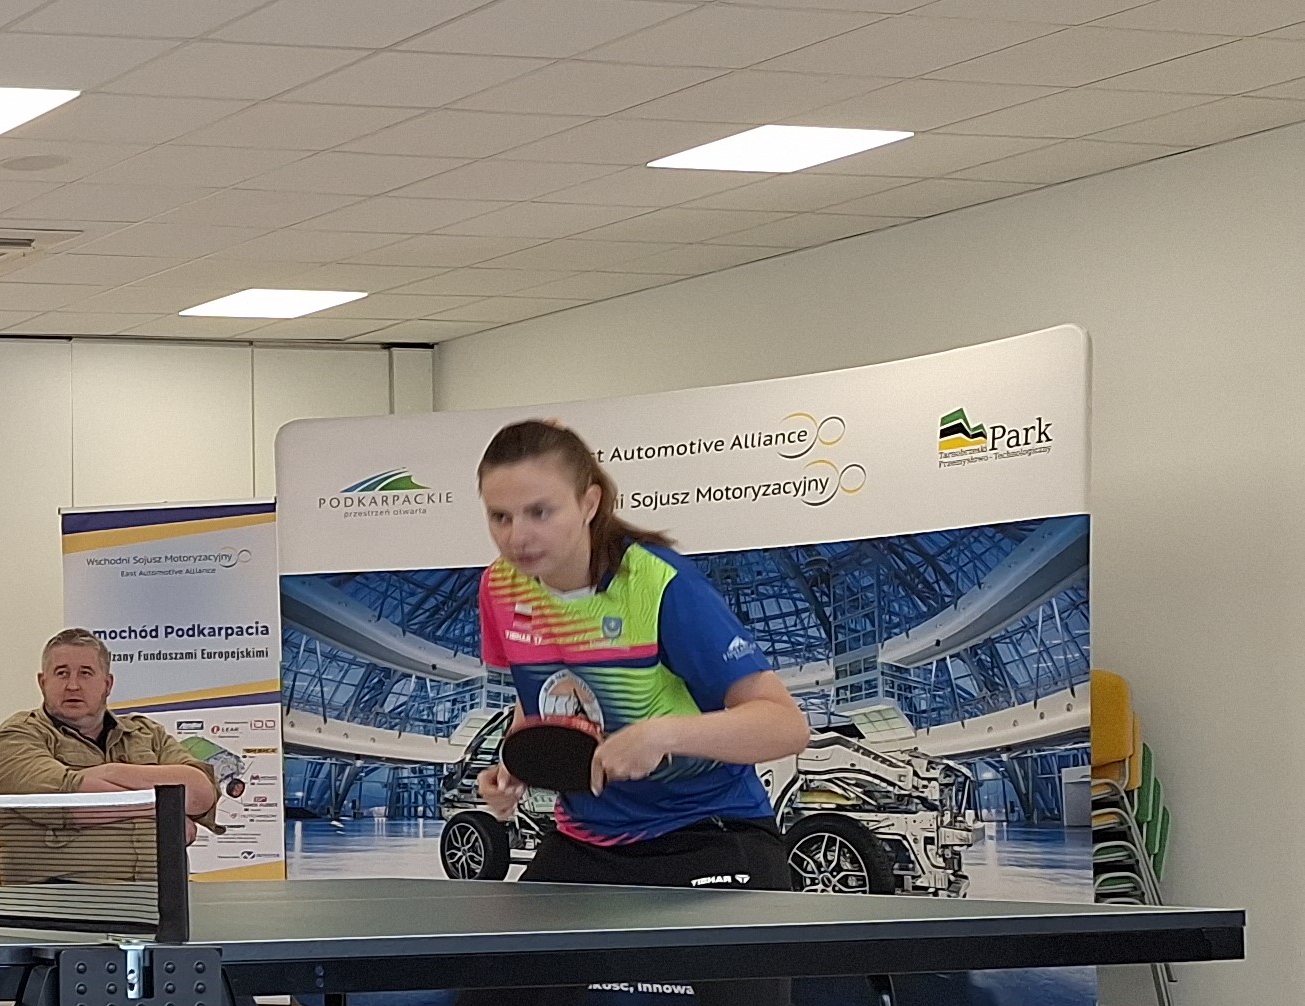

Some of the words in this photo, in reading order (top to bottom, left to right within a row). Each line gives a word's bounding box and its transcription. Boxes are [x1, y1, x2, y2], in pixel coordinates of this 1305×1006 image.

[989, 416, 1053, 452] Park
[609, 438, 725, 463] Automotive
[730, 428, 808, 450] Alliance
[318, 491, 454, 509] PODKARPACKIE
[630, 490, 690, 511] Sojusz
[696, 475, 830, 503] Motoryzacyjny
[343, 508, 390, 519] przestrzeń
[393, 507, 427, 516] otwarta
[86, 555, 131, 567] Wschodni
[132, 554, 162, 566] Sojusz
[164, 552, 233, 564] Motoryzacyjny
[164, 621, 270, 641] Podkarpacia
[137, 649, 198, 662] Funduszami
[201, 647, 269, 662] Europejskimi
